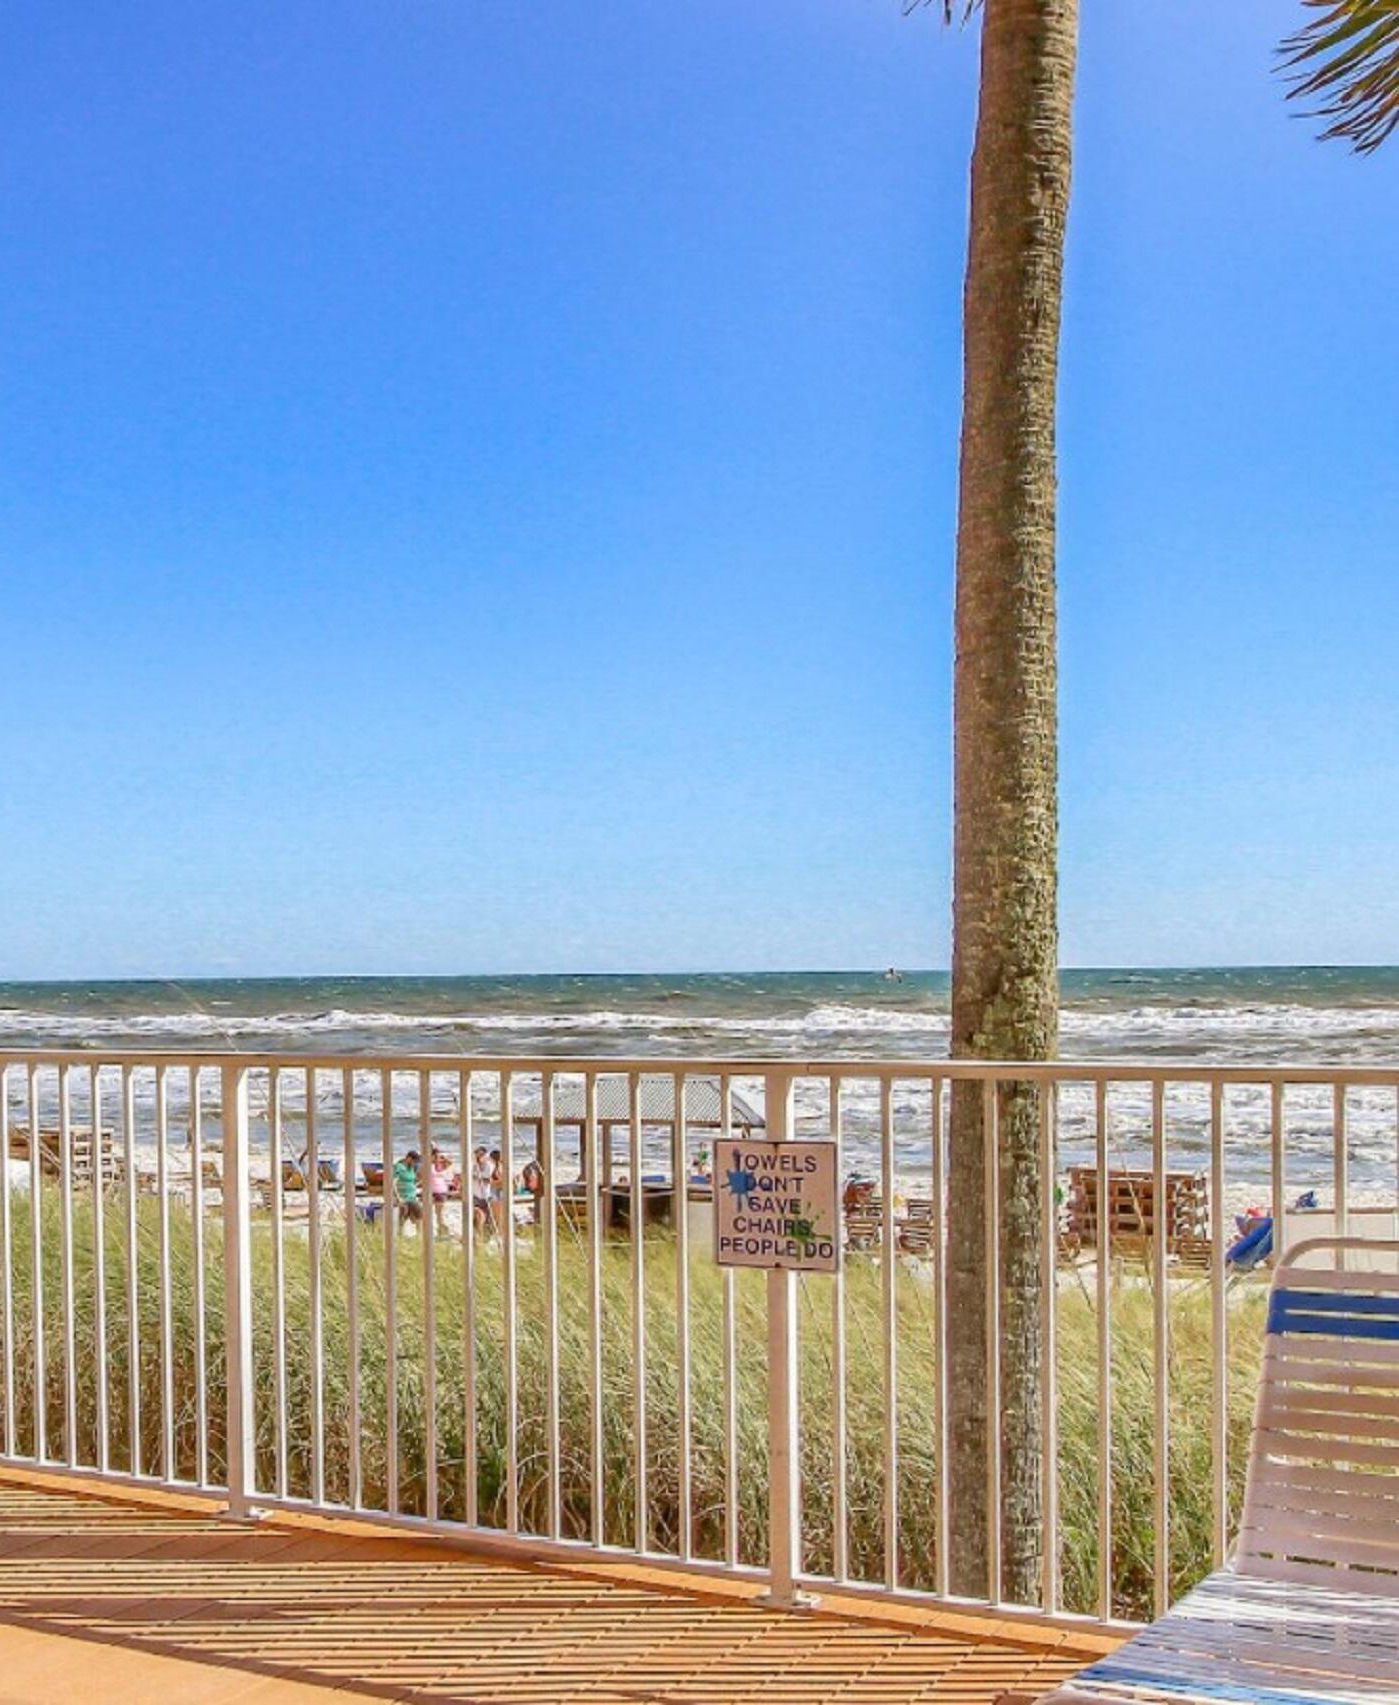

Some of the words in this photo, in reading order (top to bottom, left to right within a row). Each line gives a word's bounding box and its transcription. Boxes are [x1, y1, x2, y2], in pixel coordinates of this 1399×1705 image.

[747, 1196, 802, 1215] SAVE
[732, 1216, 811, 1236] CHAIRS
[720, 1236, 798, 1257] PEOPLE
[804, 1241, 834, 1259] DO
